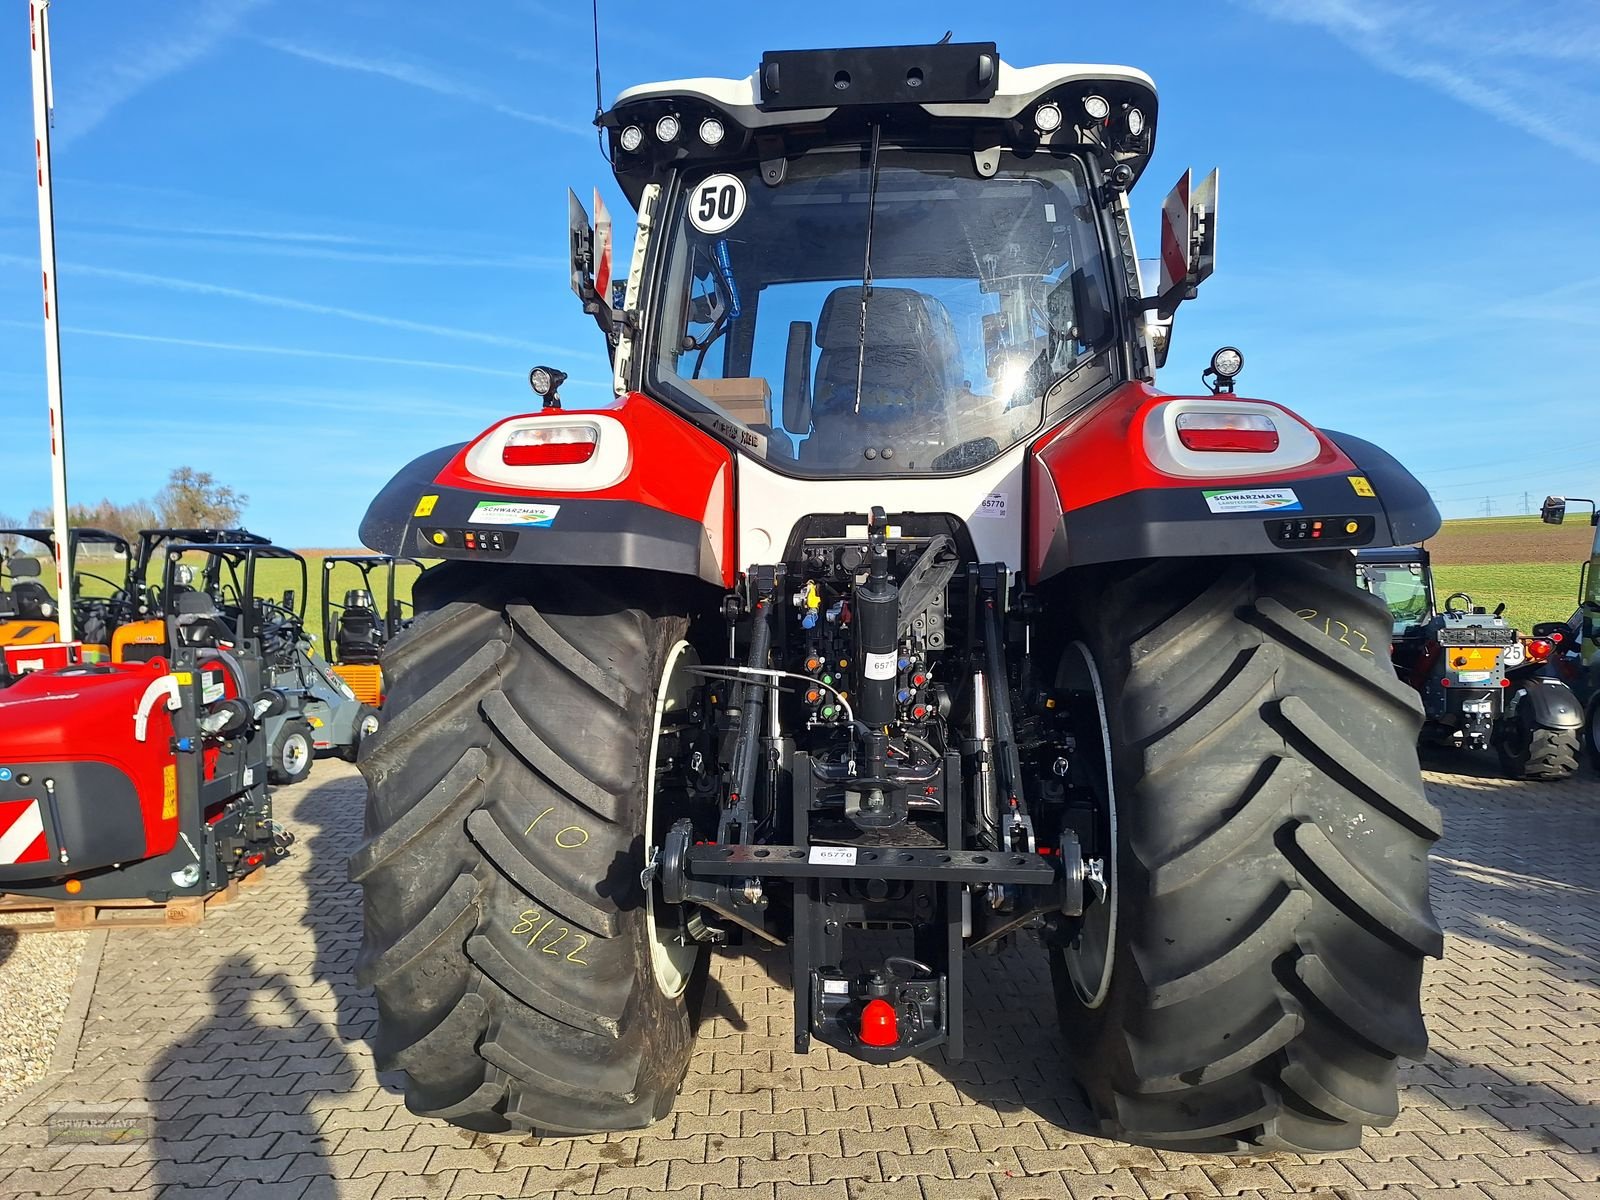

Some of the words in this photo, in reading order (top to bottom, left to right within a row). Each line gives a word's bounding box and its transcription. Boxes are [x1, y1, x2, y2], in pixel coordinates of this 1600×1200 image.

[698, 184, 737, 222] 50
[1213, 493, 1284, 501] SCHWARZMAYR
[981, 500, 1005, 508] 65770
[482, 506, 546, 514] SCHWARZMAYR
[1503, 646, 1521, 660] 25
